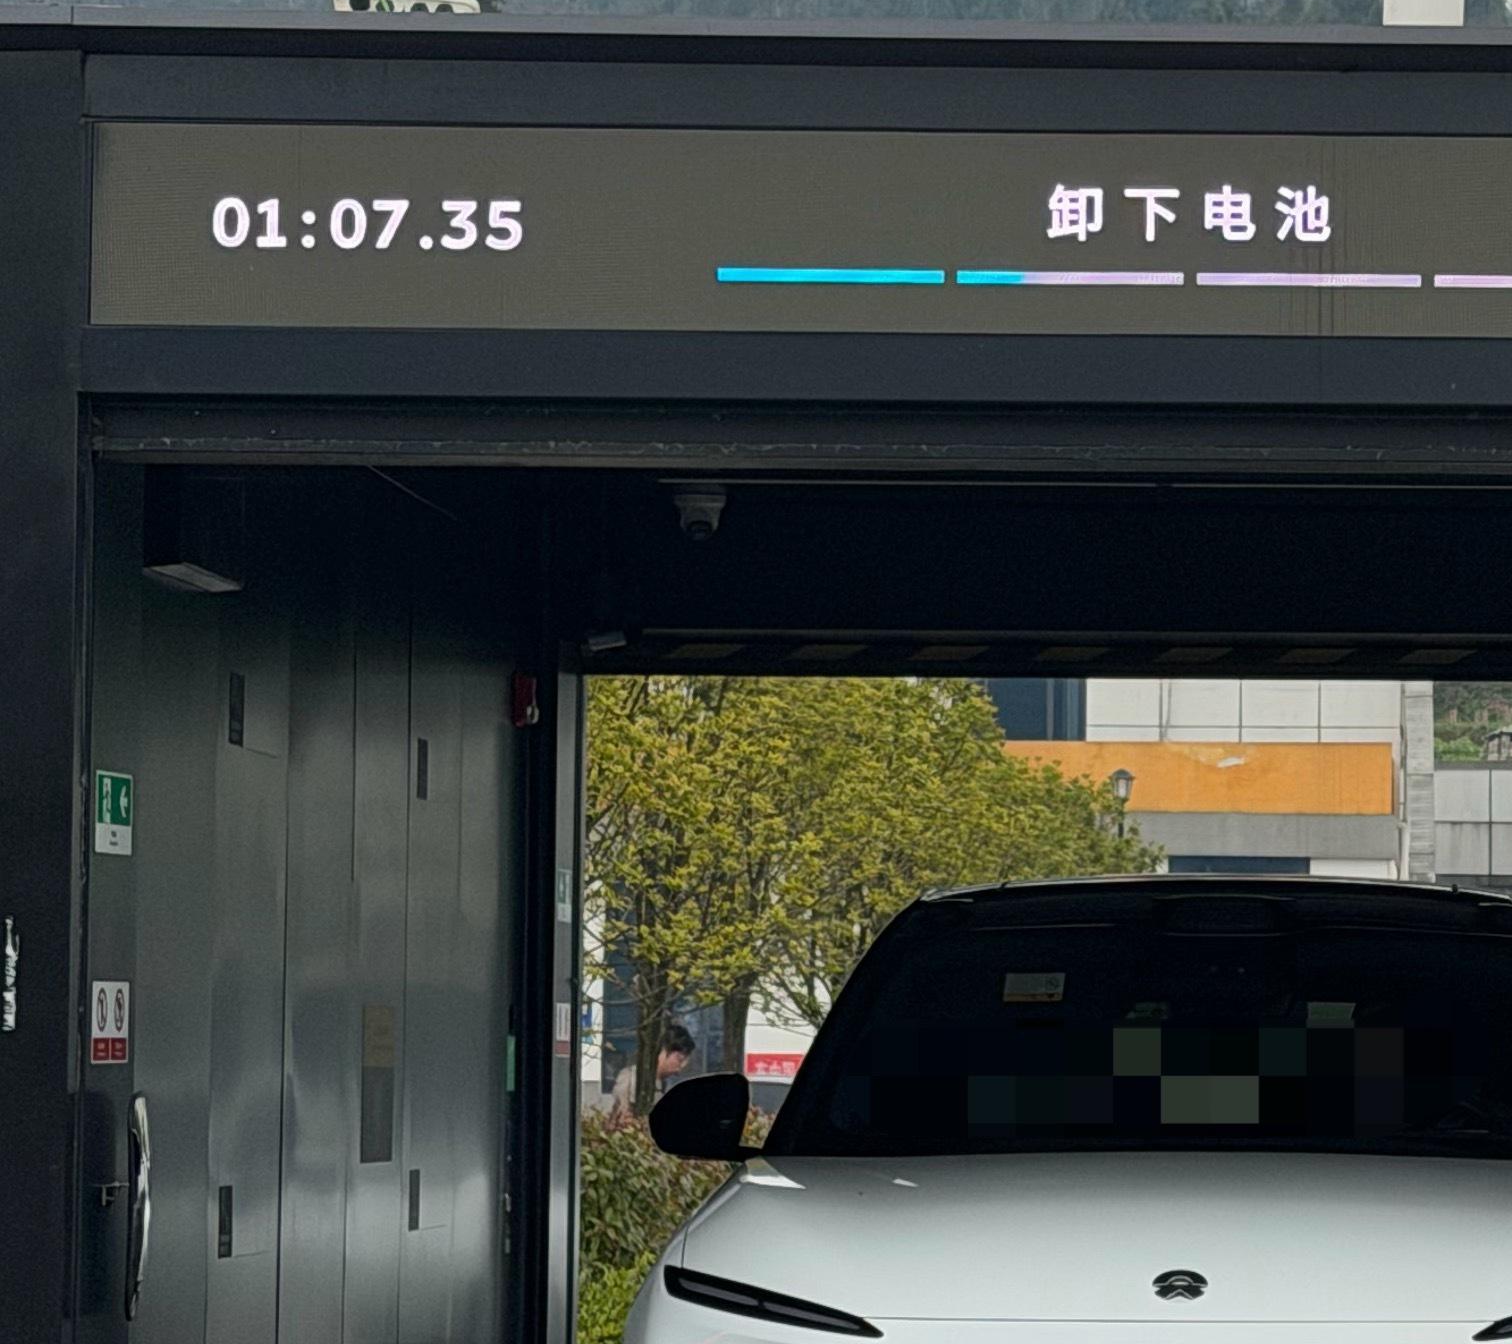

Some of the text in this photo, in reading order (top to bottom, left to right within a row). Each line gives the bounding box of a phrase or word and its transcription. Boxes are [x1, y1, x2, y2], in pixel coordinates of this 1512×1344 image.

[212, 197, 523, 251] 01:07.35
[1046, 183, 1331, 242] 卸下电池
